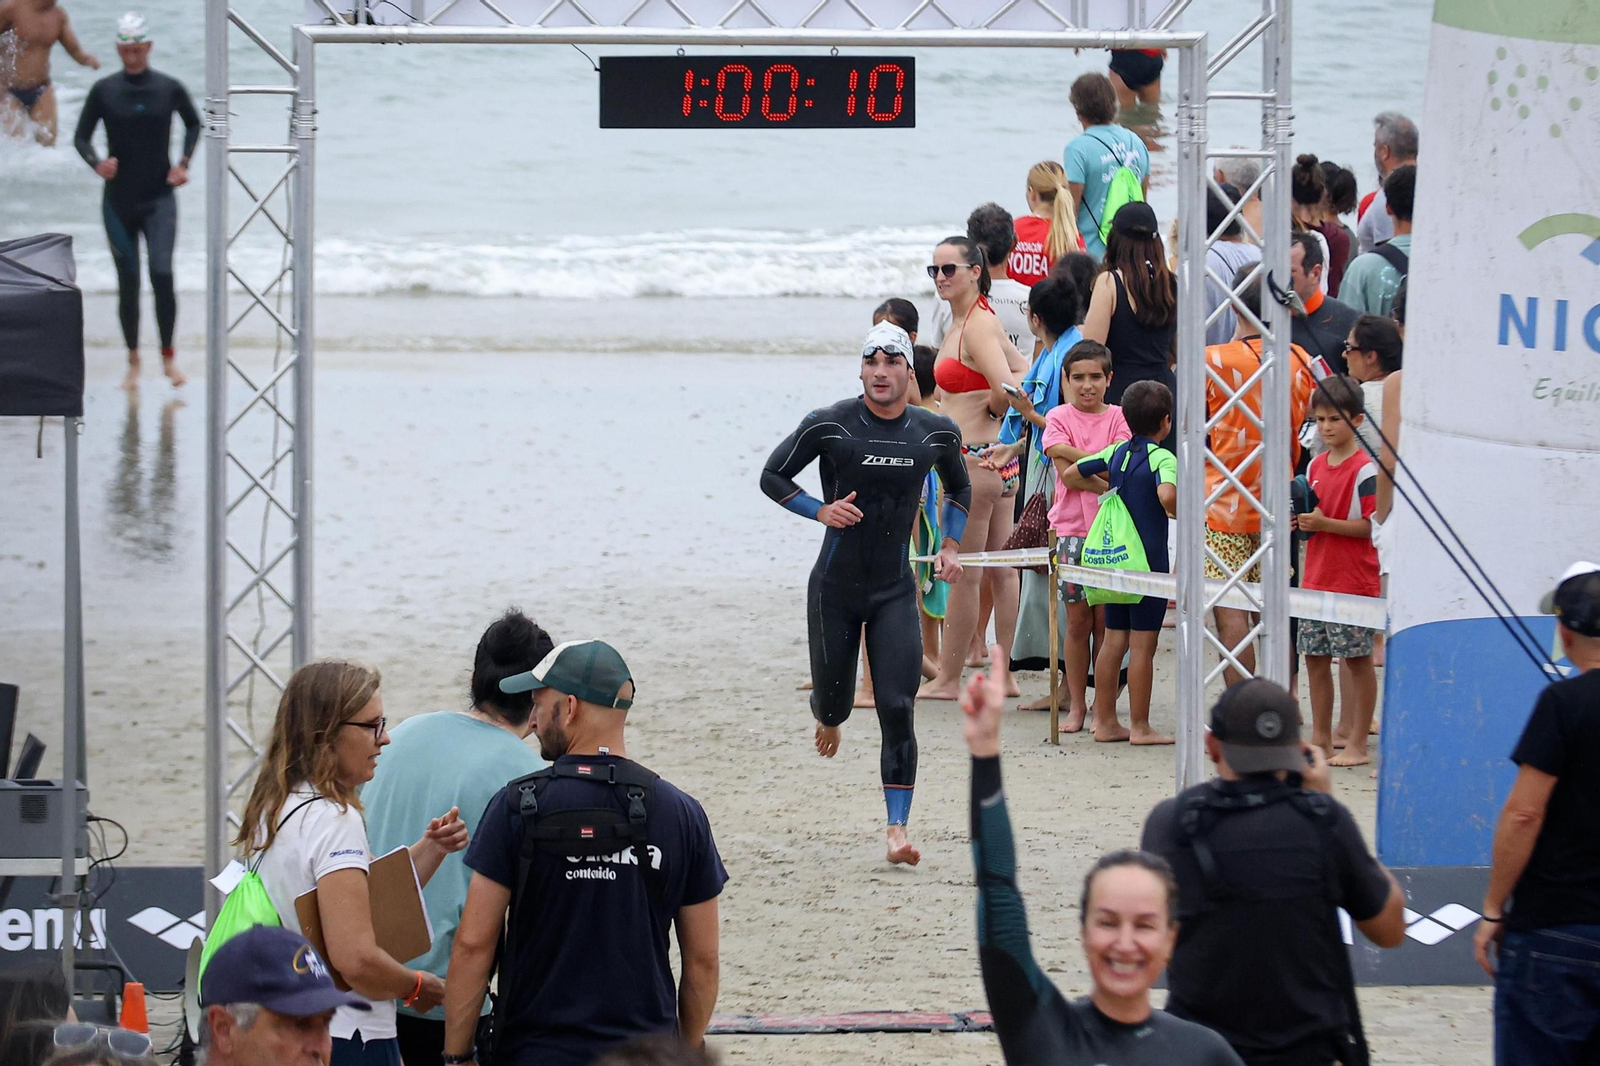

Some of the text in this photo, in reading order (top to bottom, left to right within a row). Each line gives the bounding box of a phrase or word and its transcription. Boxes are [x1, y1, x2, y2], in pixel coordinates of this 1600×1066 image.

[1083, 552, 1130, 565] Costa Sena
[565, 865, 617, 881] contenido
